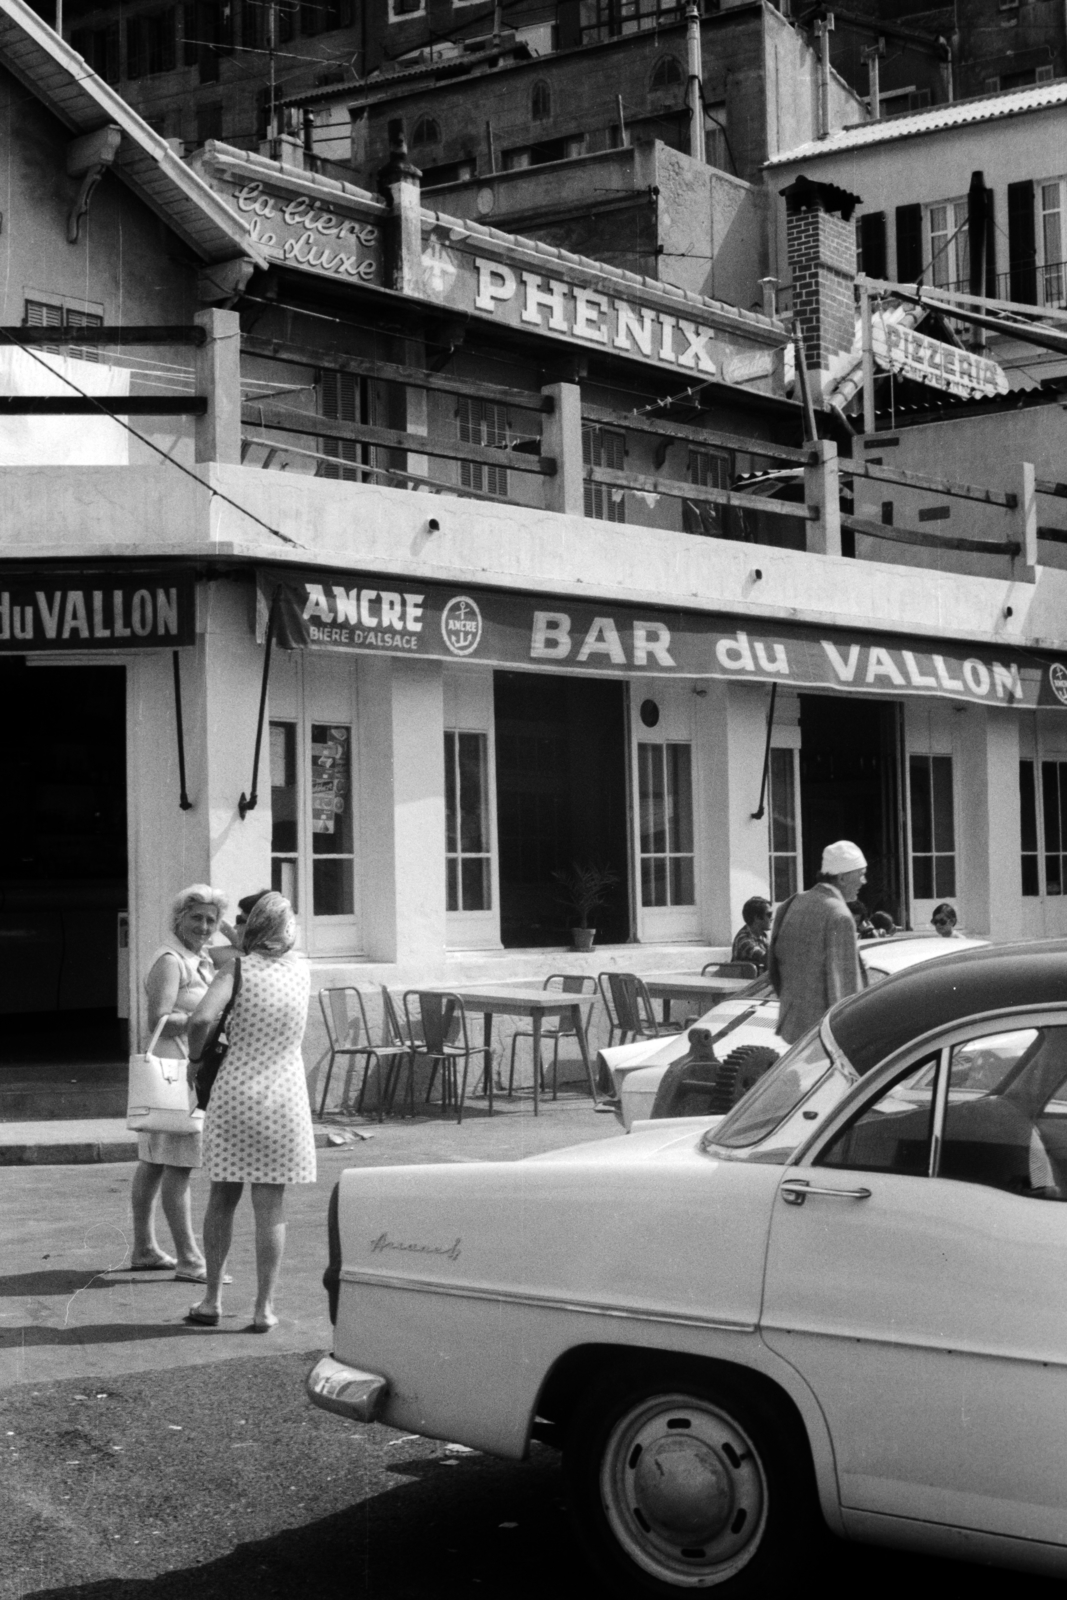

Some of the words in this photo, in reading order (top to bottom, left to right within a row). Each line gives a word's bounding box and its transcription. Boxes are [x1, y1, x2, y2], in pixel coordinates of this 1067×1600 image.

[233, 181, 276, 219] la
[281, 196, 378, 247] bière
[886, 323, 998, 391] PIZZERIA
[34, 587, 179, 640] VALLON
[303, 583, 426, 632] ANCRE
[447, 619, 478, 633] ANCRE
[309, 625, 350, 643] BIÈRE
[354, 629, 418, 650] D'ALSACE
[530, 611, 677, 667] BAR
[715, 630, 790, 674] du
[820, 639, 1025, 699] VALLON
